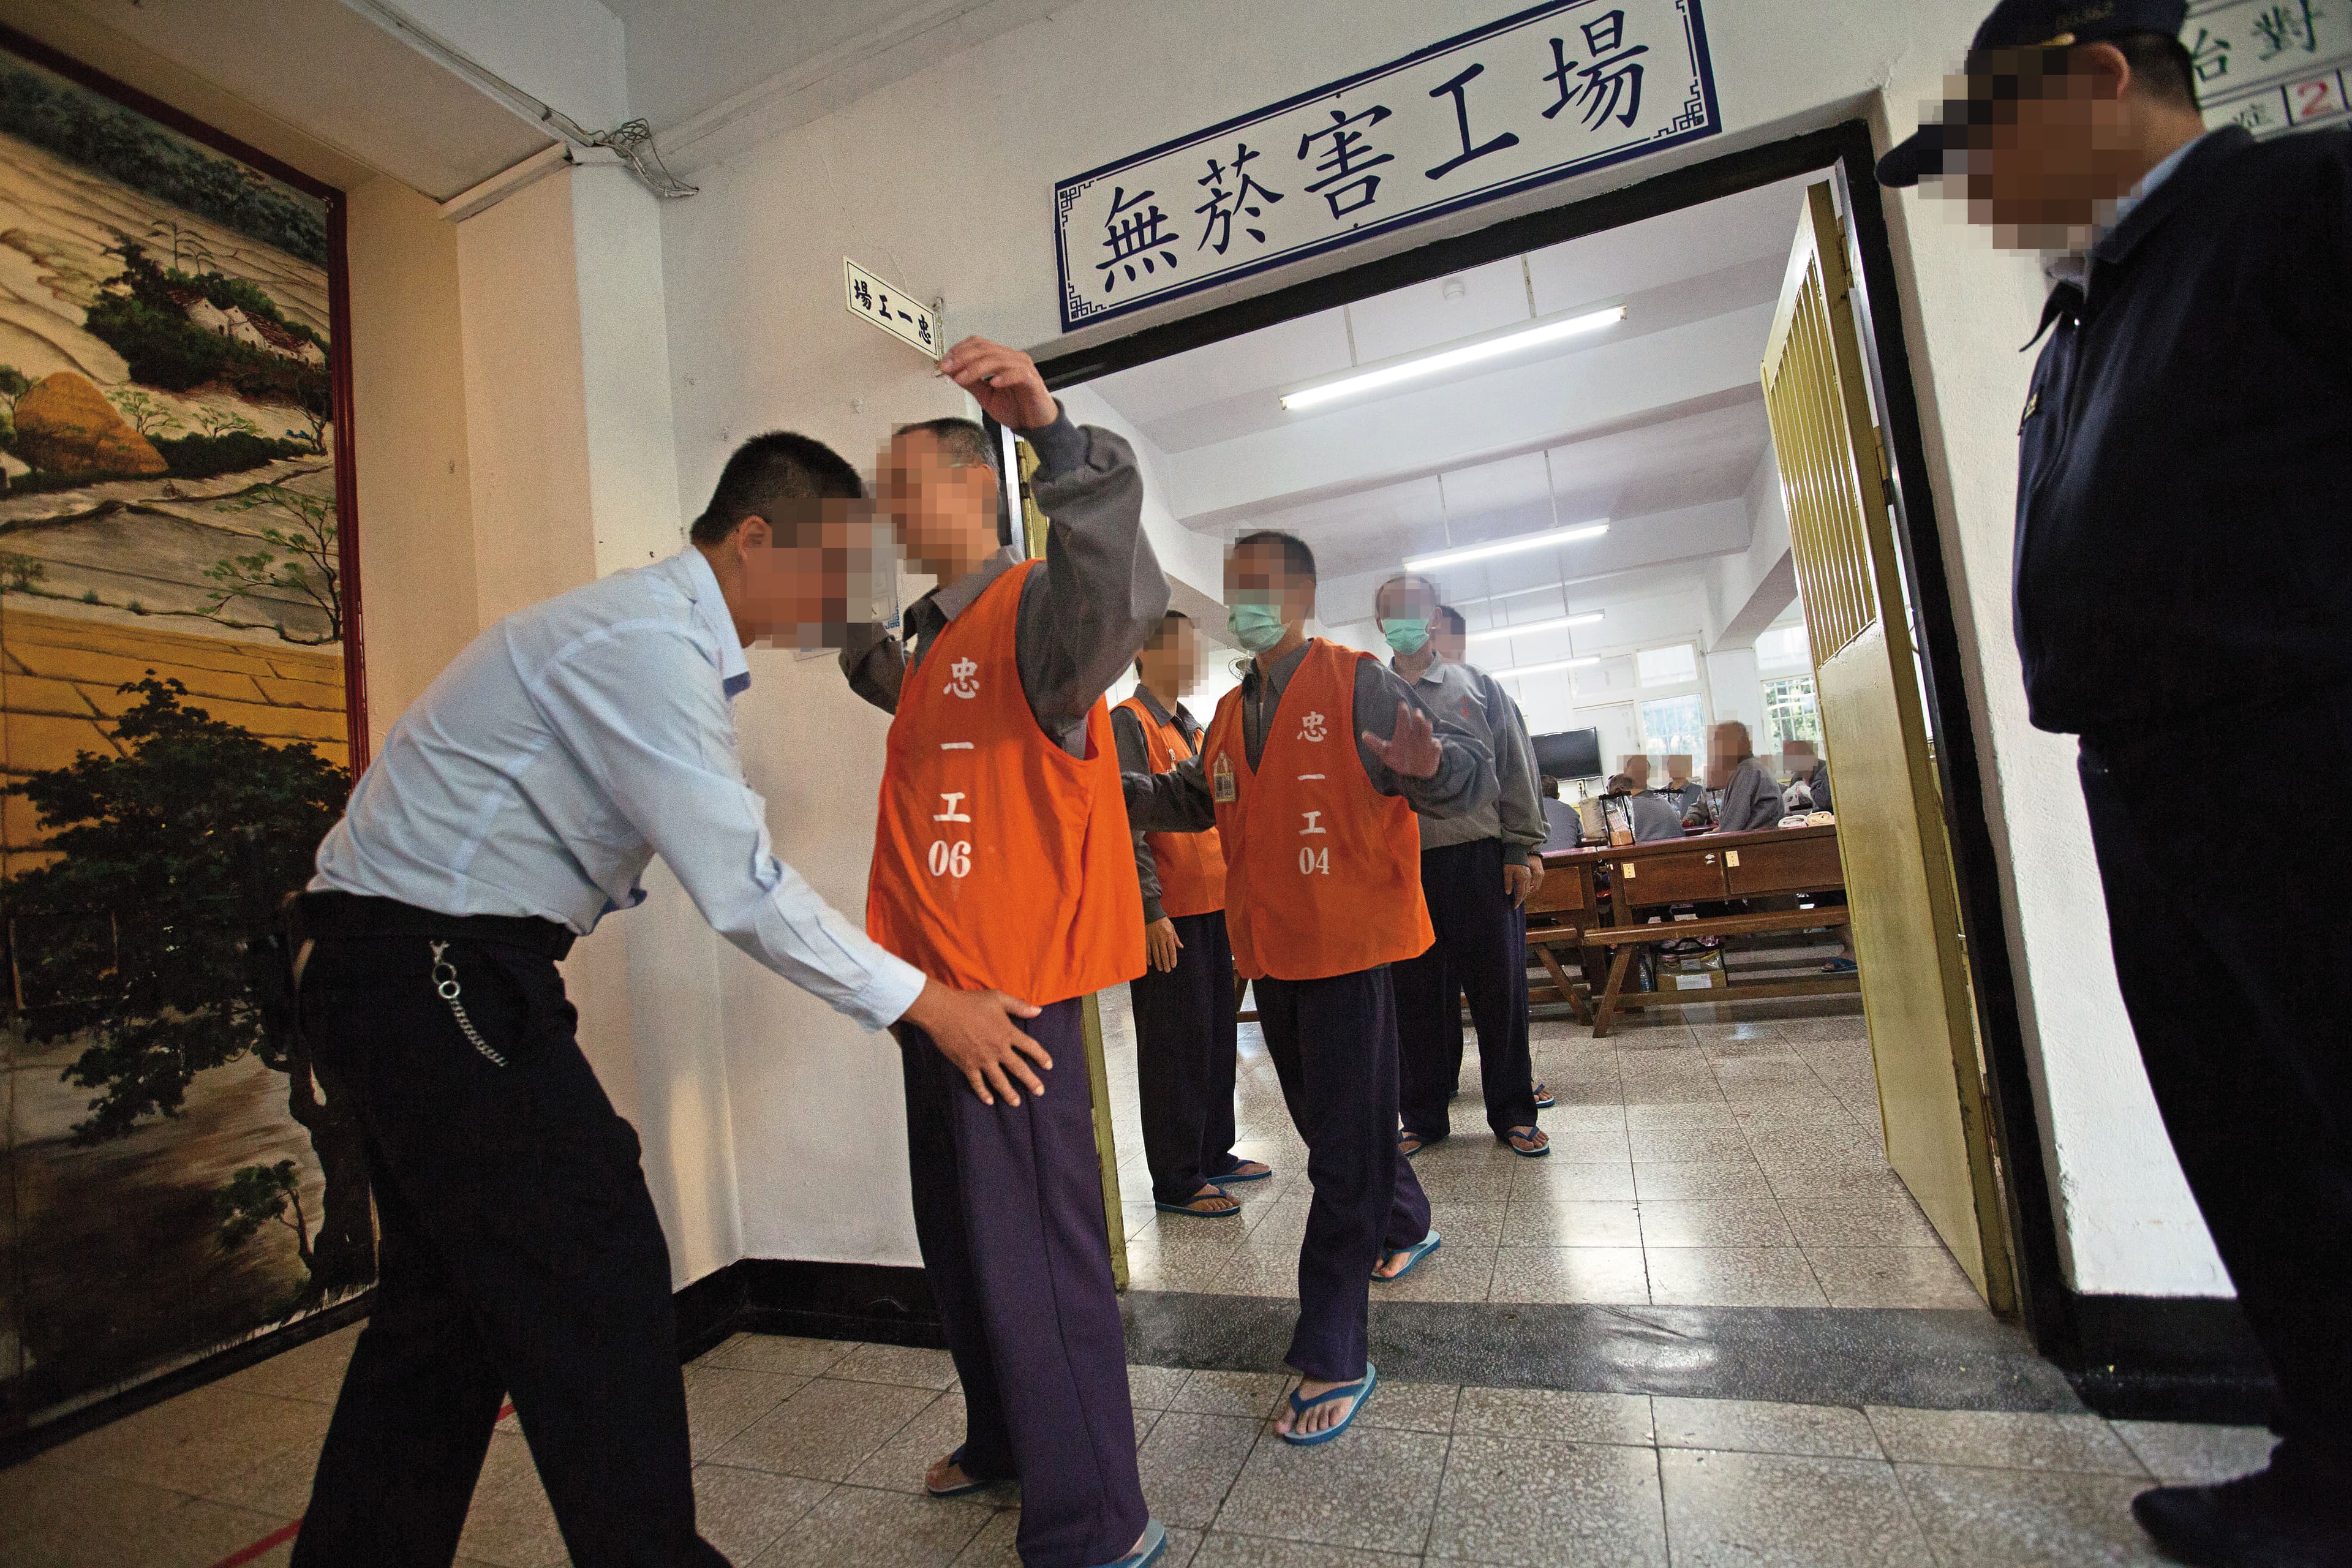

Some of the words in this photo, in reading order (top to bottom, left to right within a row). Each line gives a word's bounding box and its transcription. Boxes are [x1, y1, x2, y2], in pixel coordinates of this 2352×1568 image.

[1095, 9, 1649, 293] 無菸害工場
[2297, 81, 2334, 117] 2
